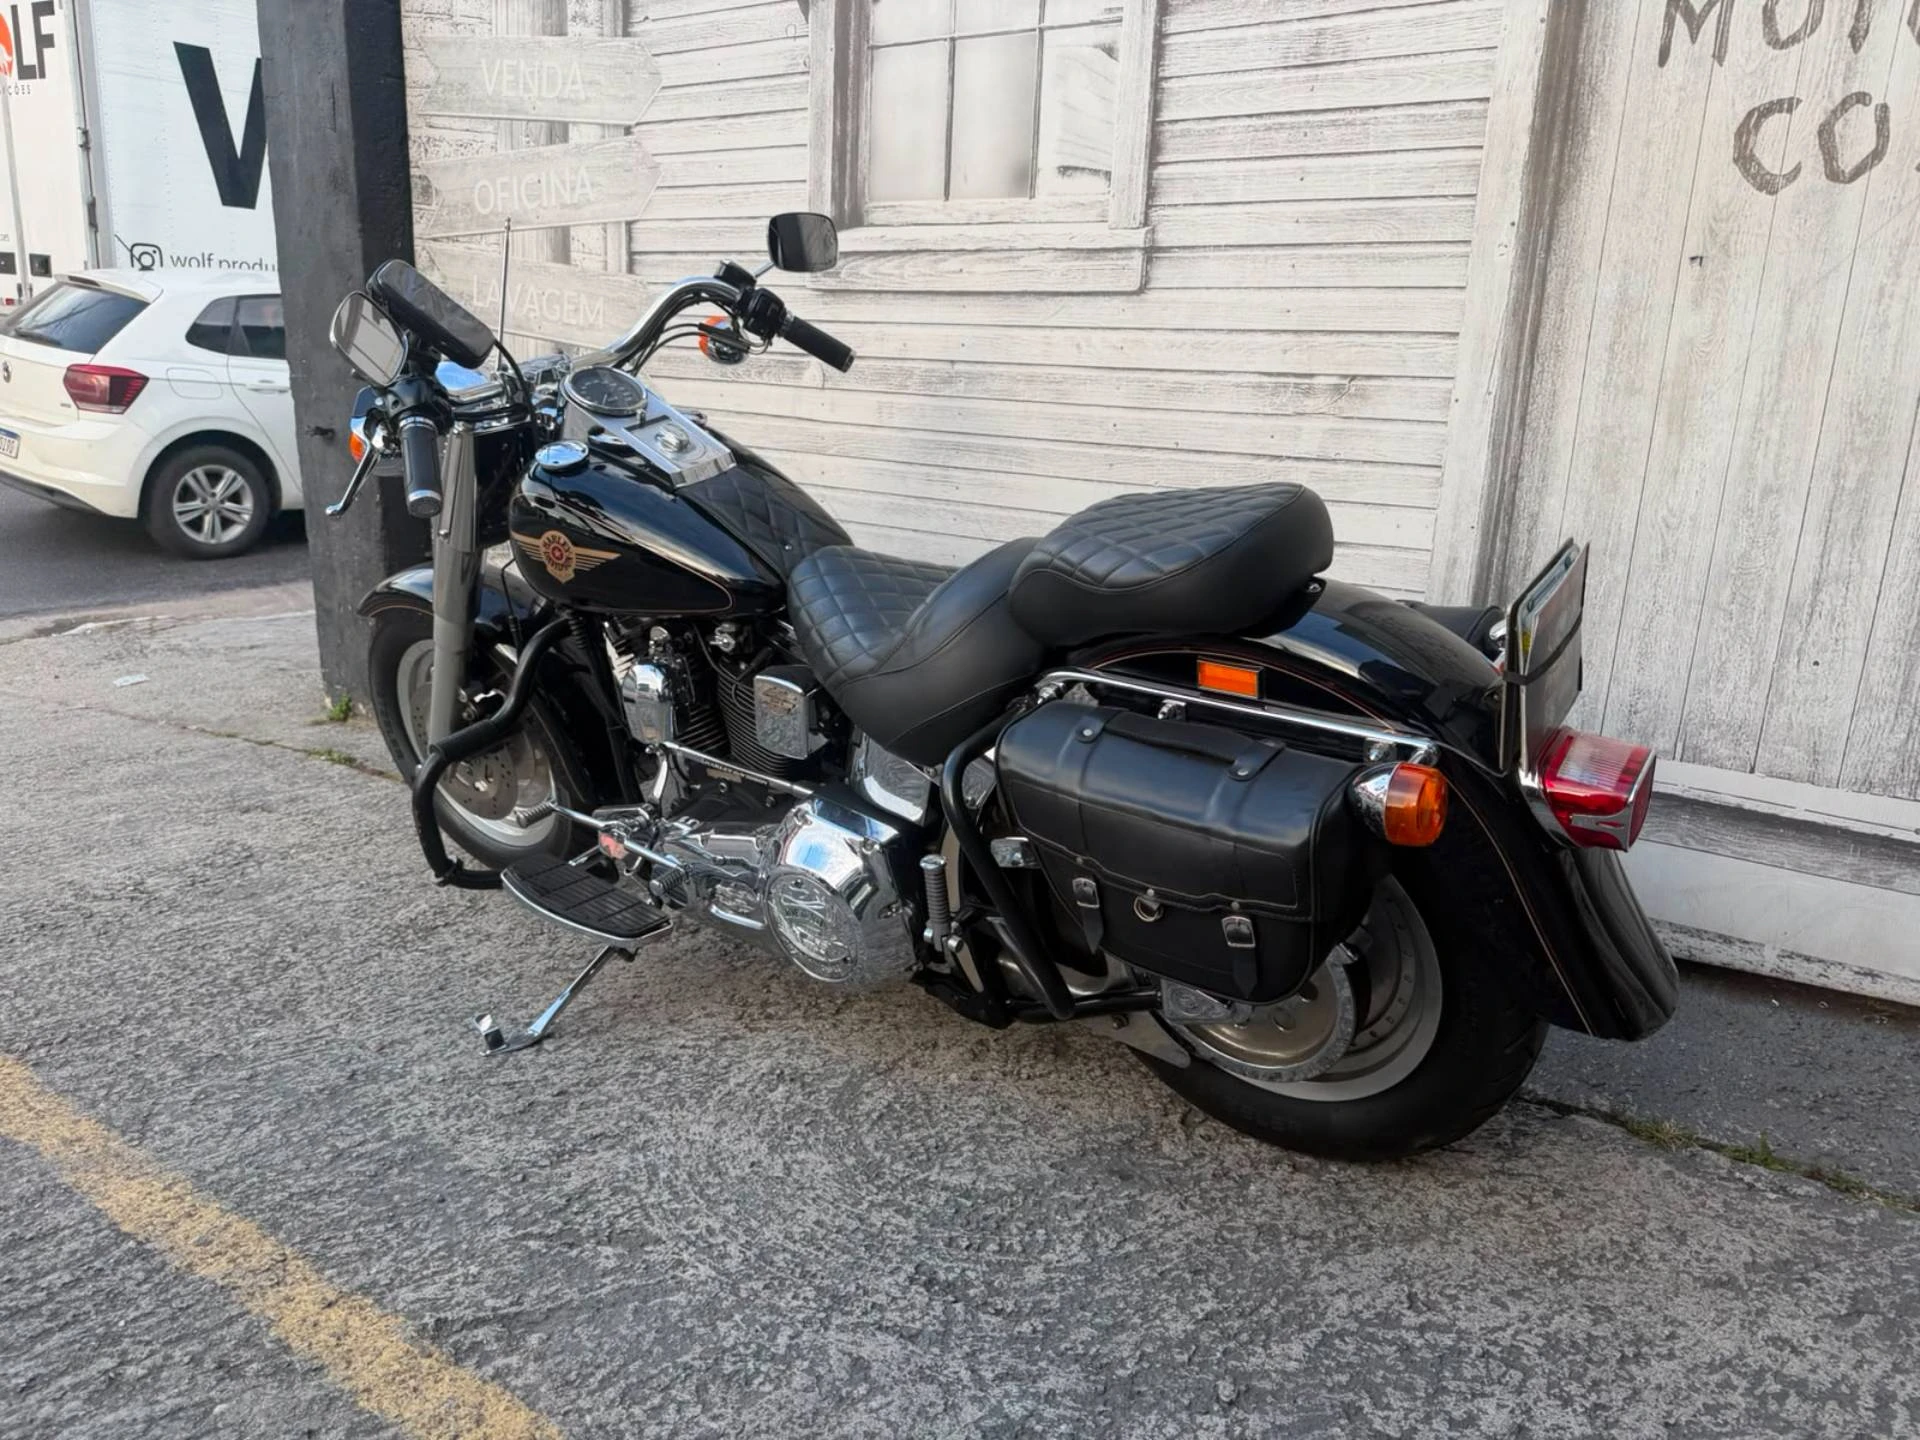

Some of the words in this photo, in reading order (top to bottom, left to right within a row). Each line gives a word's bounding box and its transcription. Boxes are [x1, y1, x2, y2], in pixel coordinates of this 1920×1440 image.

[0, 0, 55, 80] LF
[480, 57, 586, 101] VENDA
[473, 166, 594, 215] OFICINA
[471, 274, 605, 329] LAVAGEM
